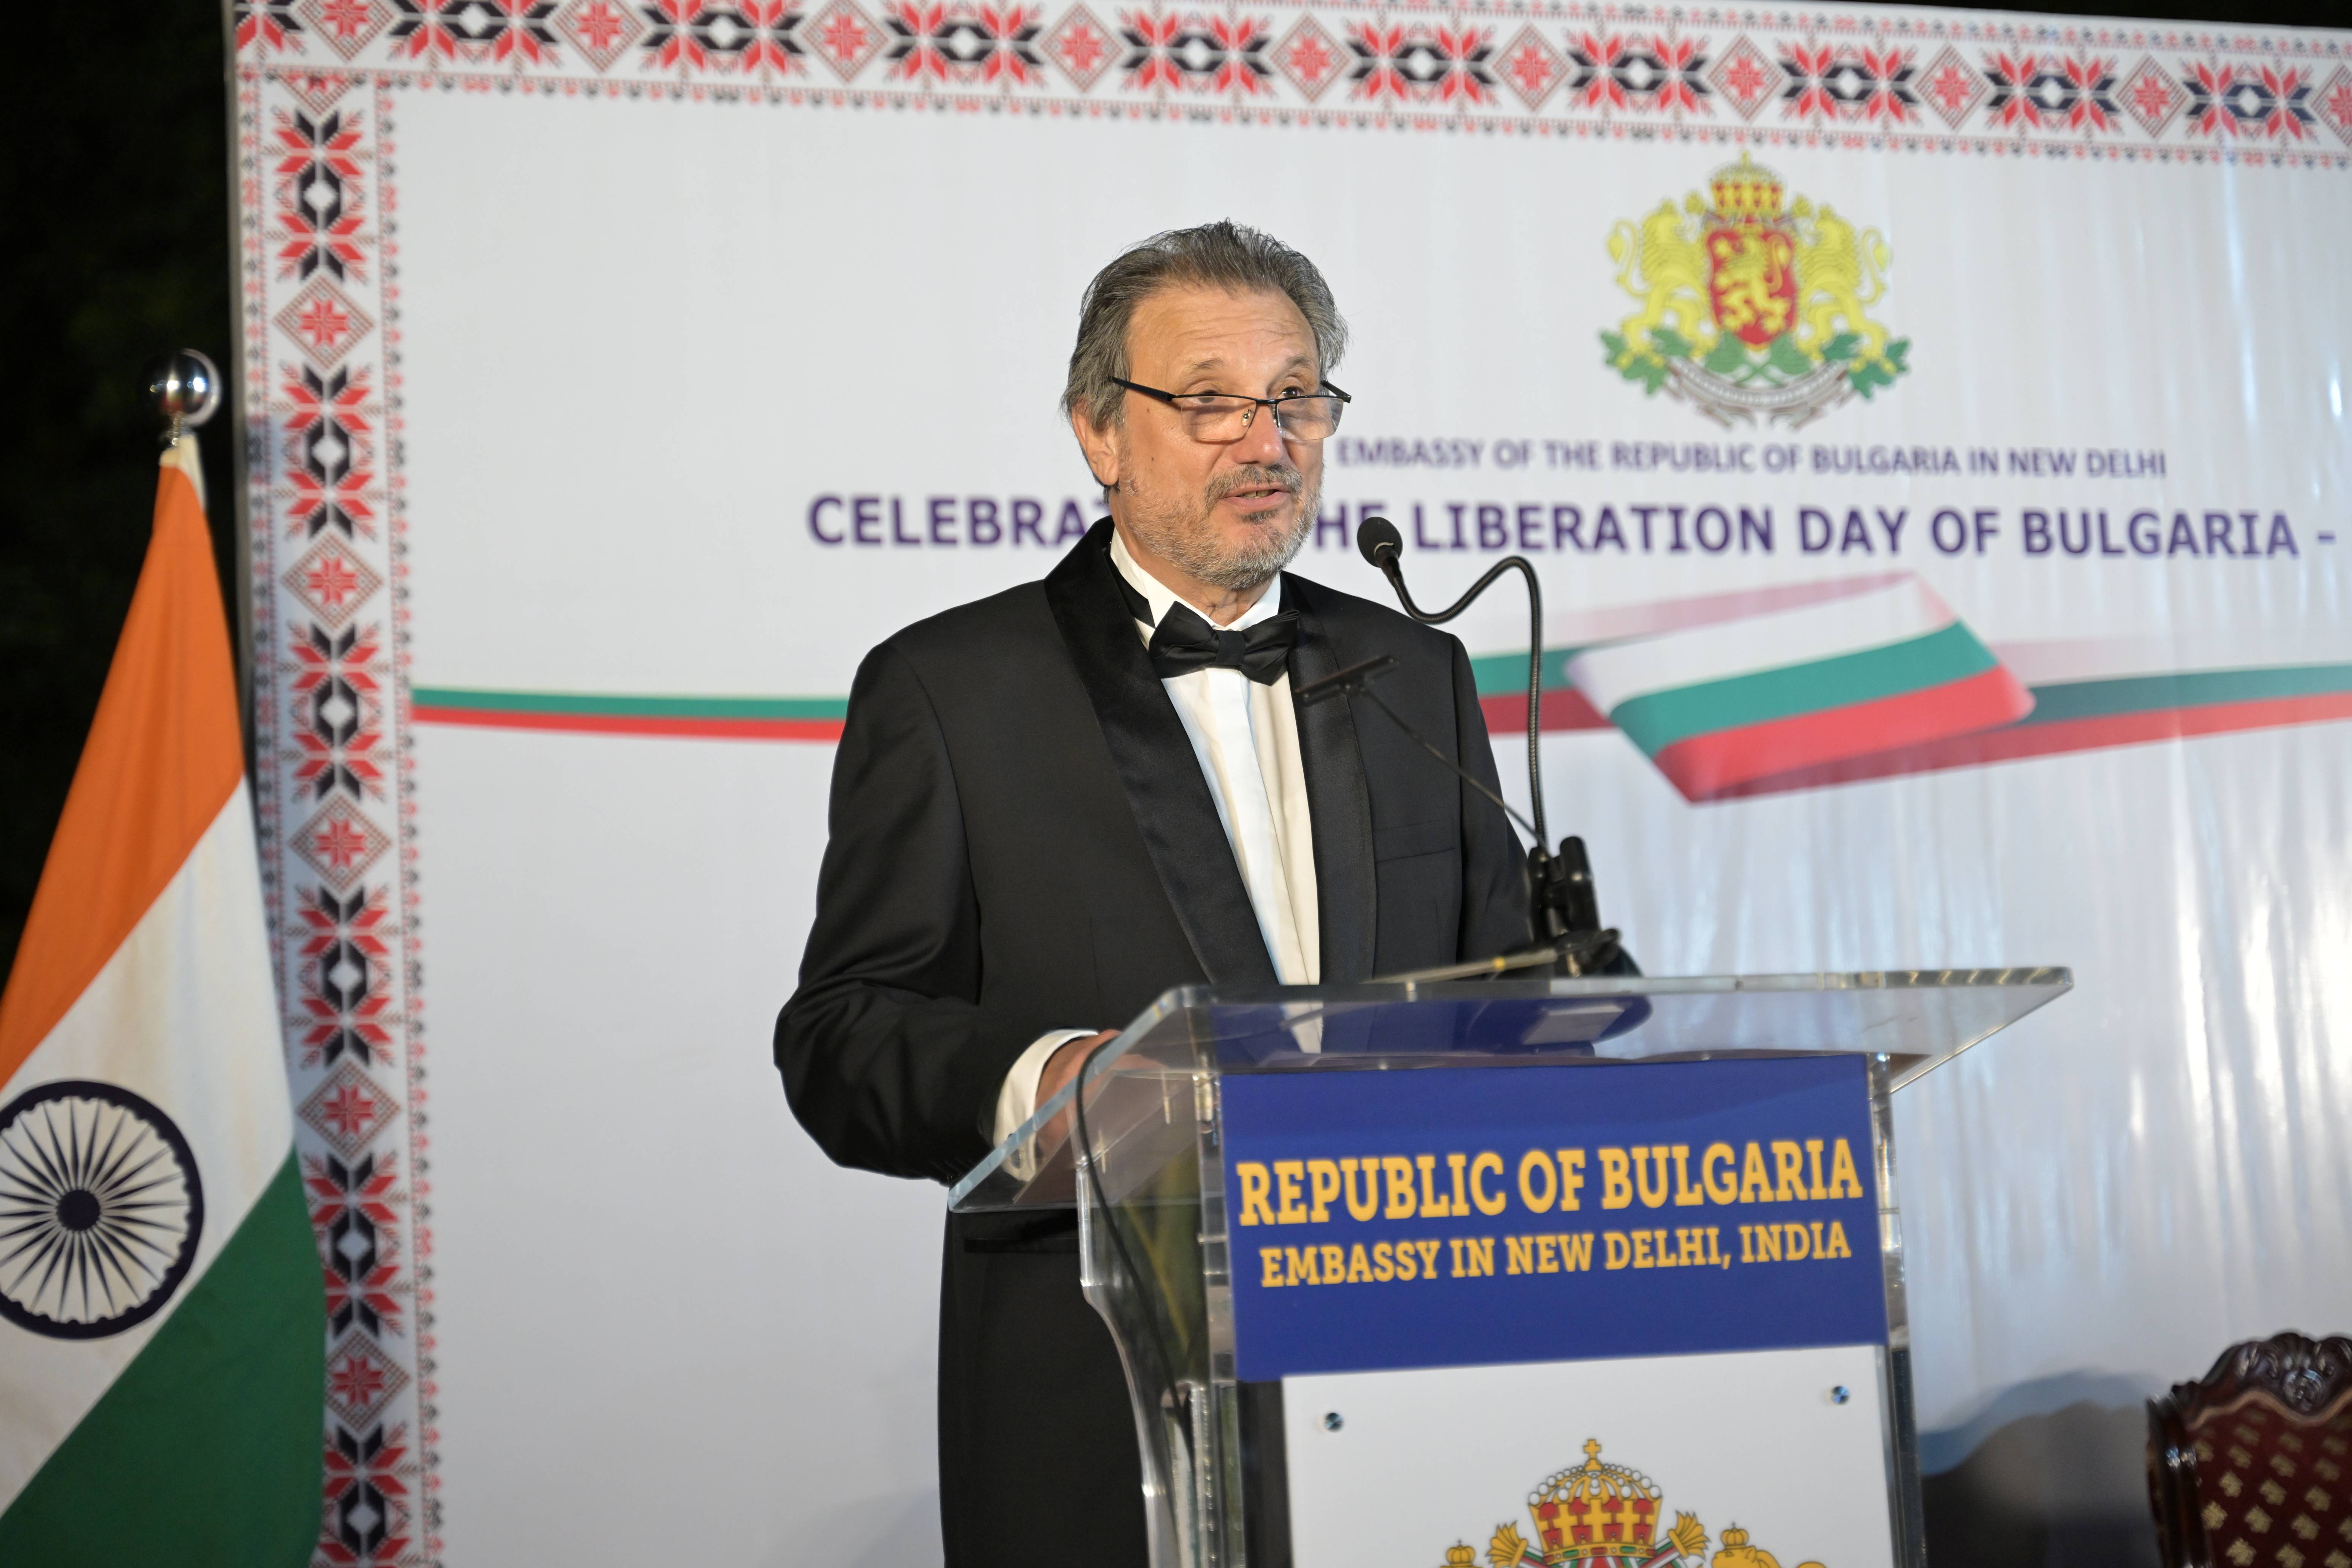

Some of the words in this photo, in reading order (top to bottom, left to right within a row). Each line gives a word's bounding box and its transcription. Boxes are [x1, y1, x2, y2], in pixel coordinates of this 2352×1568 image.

[1336, 438, 1484, 467] EMBASSY
[1492, 439, 1532, 468] OF
[1543, 440, 1599, 469] THE
[1610, 441, 1754, 472] REPUBLIC
[1761, 444, 1800, 472] OF
[1810, 445, 1962, 475] BULGARIA
[1968, 447, 2000, 474] IN
[2006, 447, 2077, 476] NEW
[2084, 449, 2167, 477] DELHI
[1412, 502, 1775, 555] LIBERATION
[1797, 506, 1908, 555] DAY
[1929, 507, 2000, 557] OF
[2020, 509, 2300, 559] BULGARIA
[1236, 1152, 1506, 1227] REPUBLIC
[1518, 1149, 1585, 1214] OF
[1598, 1138, 1863, 1210] BULGARIA
[1260, 1240, 1440, 1288] EMBASSY
[1449, 1237, 1495, 1278] IN
[1505, 1233, 1595, 1275] NEW
[1603, 1227, 1731, 1270] DELHI,
[1739, 1221, 1852, 1263] INDIA
